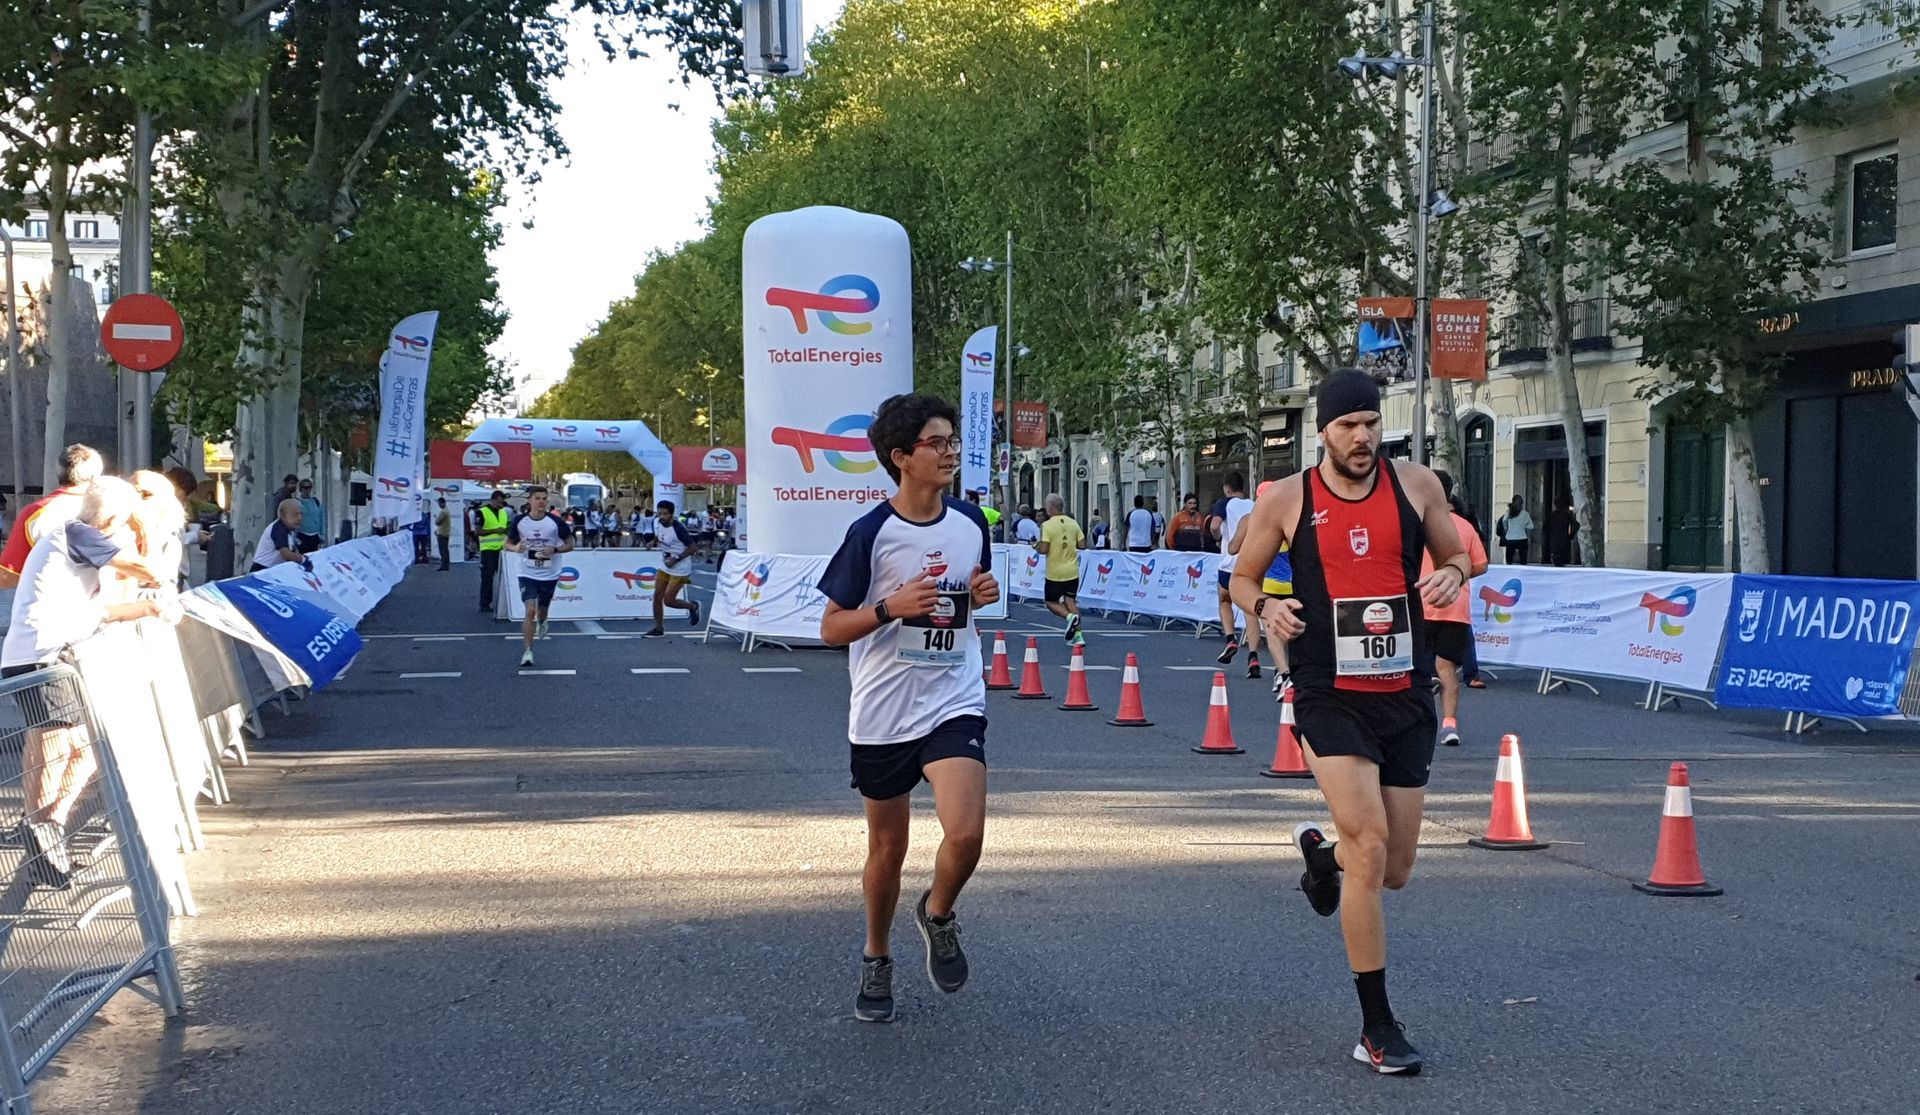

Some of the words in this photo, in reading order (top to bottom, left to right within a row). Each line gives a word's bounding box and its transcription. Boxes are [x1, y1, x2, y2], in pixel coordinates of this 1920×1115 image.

[1361, 306, 1384, 317] ISLA
[1436, 313, 1480, 323] FERNÁN
[1436, 321, 1480, 333] GÓMEZ
[1756, 312, 1800, 333] RADA
[768, 348, 882, 366] TotalEnergies
[773, 486, 888, 504] TotalEnergies
[1778, 596, 1911, 645] MADRID
[306, 635, 331, 662] ES
[923, 629, 955, 651] 140
[1360, 635, 1396, 659] 160
[1628, 643, 1684, 665] TotalEnergies
[1727, 667, 1747, 688] ES
[1747, 668, 1812, 692] DEPORTE
